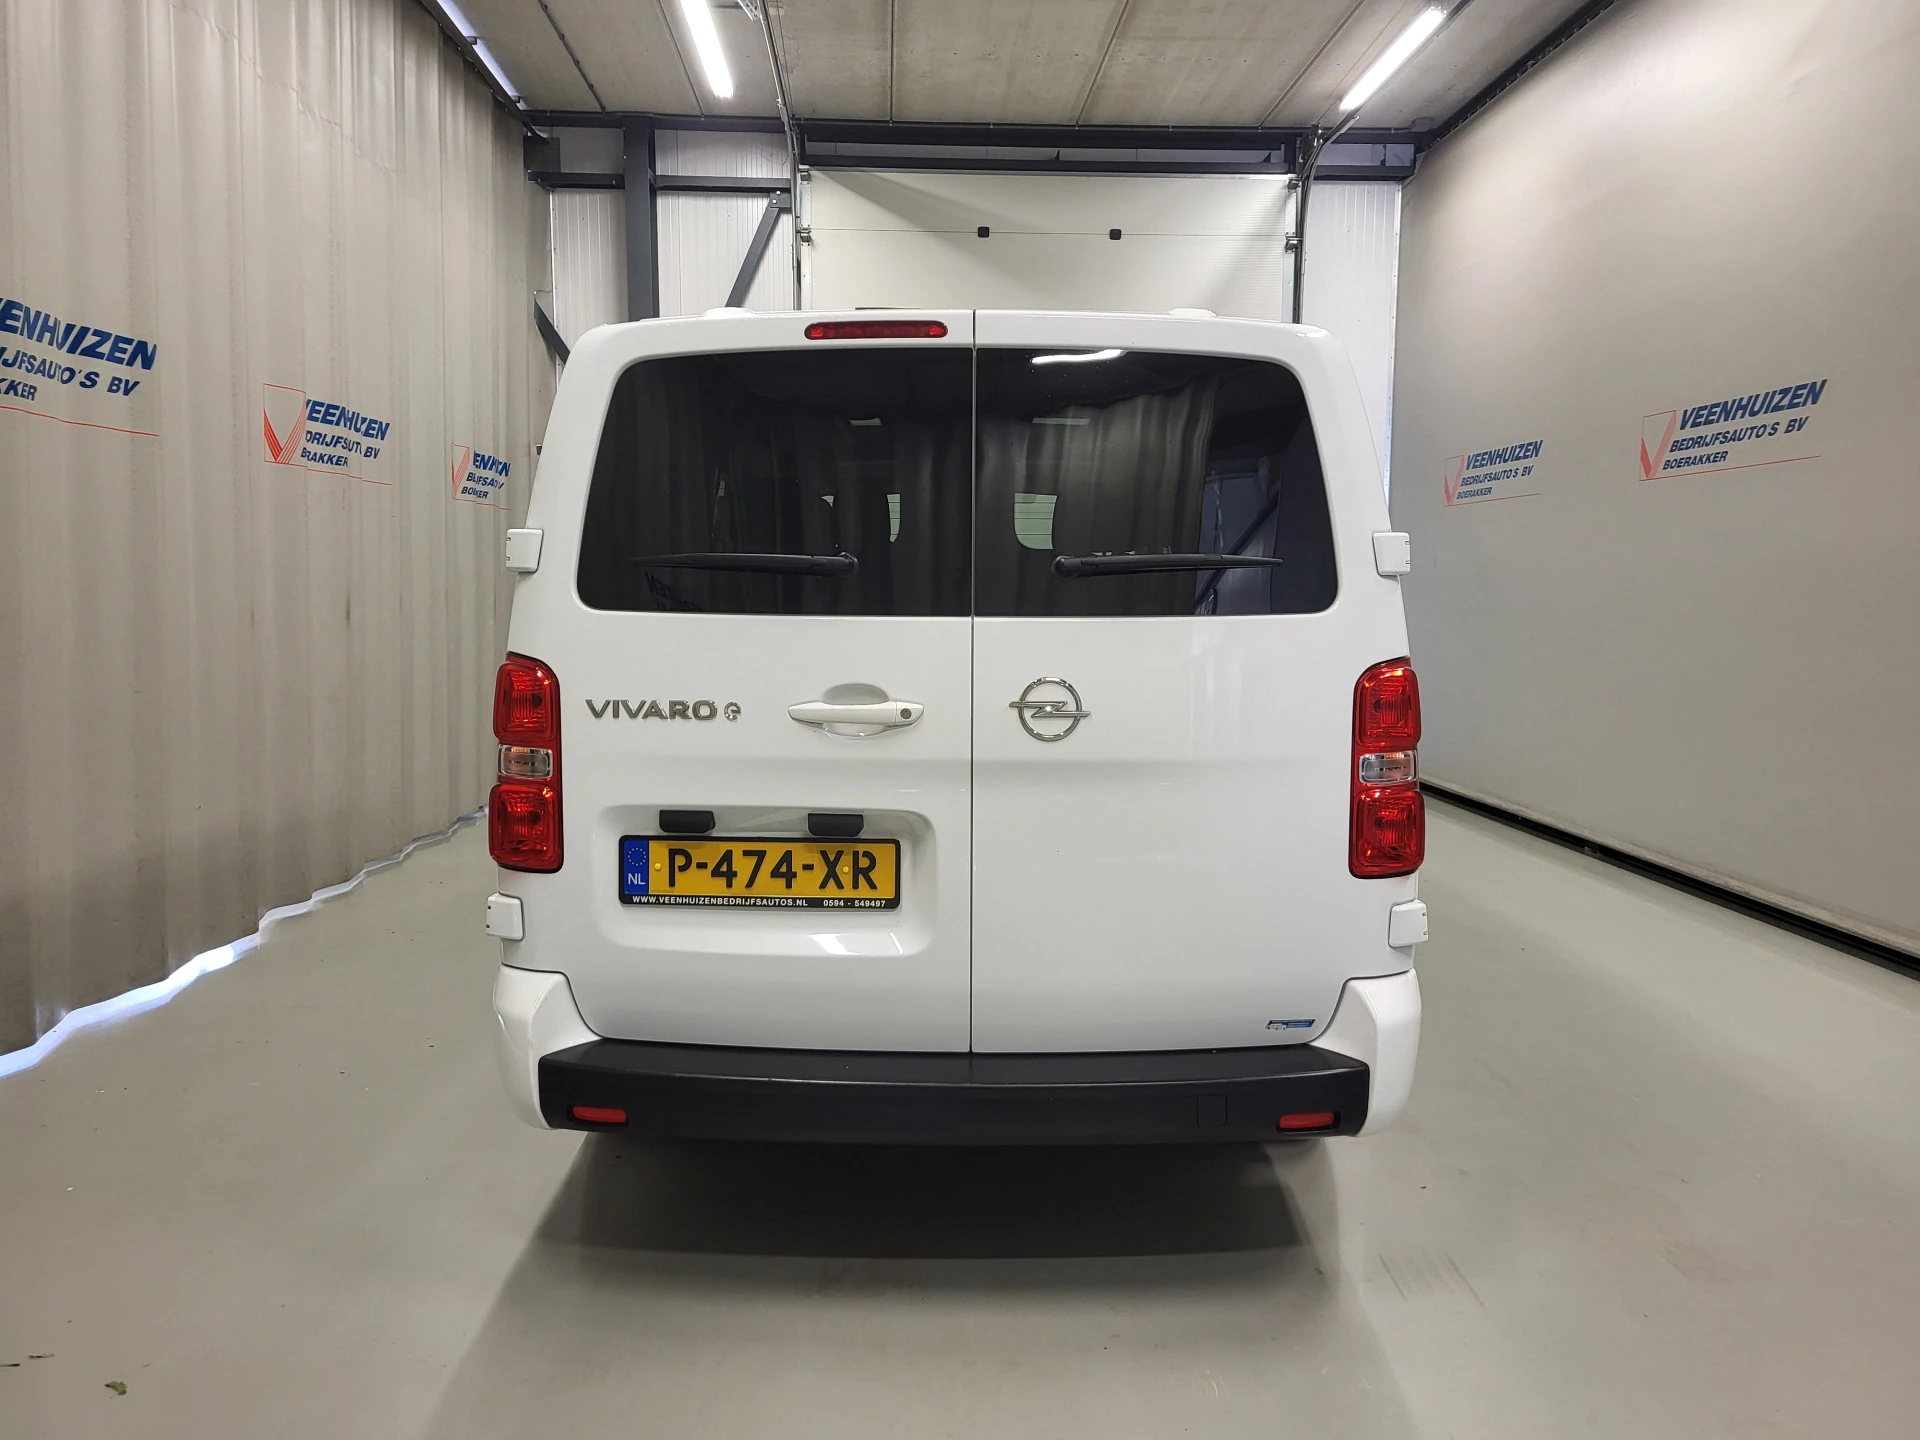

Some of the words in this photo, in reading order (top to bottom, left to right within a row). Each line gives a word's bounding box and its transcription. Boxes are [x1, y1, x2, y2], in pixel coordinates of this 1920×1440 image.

[0, 298, 157, 370] ENHUIZEN
[107, 376, 141, 396] BV
[1679, 378, 1829, 430] VEENHUIZEN
[1669, 421, 1780, 453] BEDRIJFSAUTO'S
[1783, 416, 1810, 434] BV
[363, 446, 381, 459] BV
[1466, 440, 1543, 470] VEENHUIZEN
[1662, 450, 1729, 470] BOERAKKER
[1521, 465, 1534, 477] BV
[1456, 487, 1492, 499] BOERAKKER
[585, 699, 718, 720] VIVARO
[628, 873, 645, 885] NL
[668, 848, 878, 890] P-474-XR
[632, 895, 808, 907] WWW.VEENHUIZENBEDRIJFSAUTOS.NL
[823, 899, 844, 907] 0594
[854, 900, 886, 908] 549497
